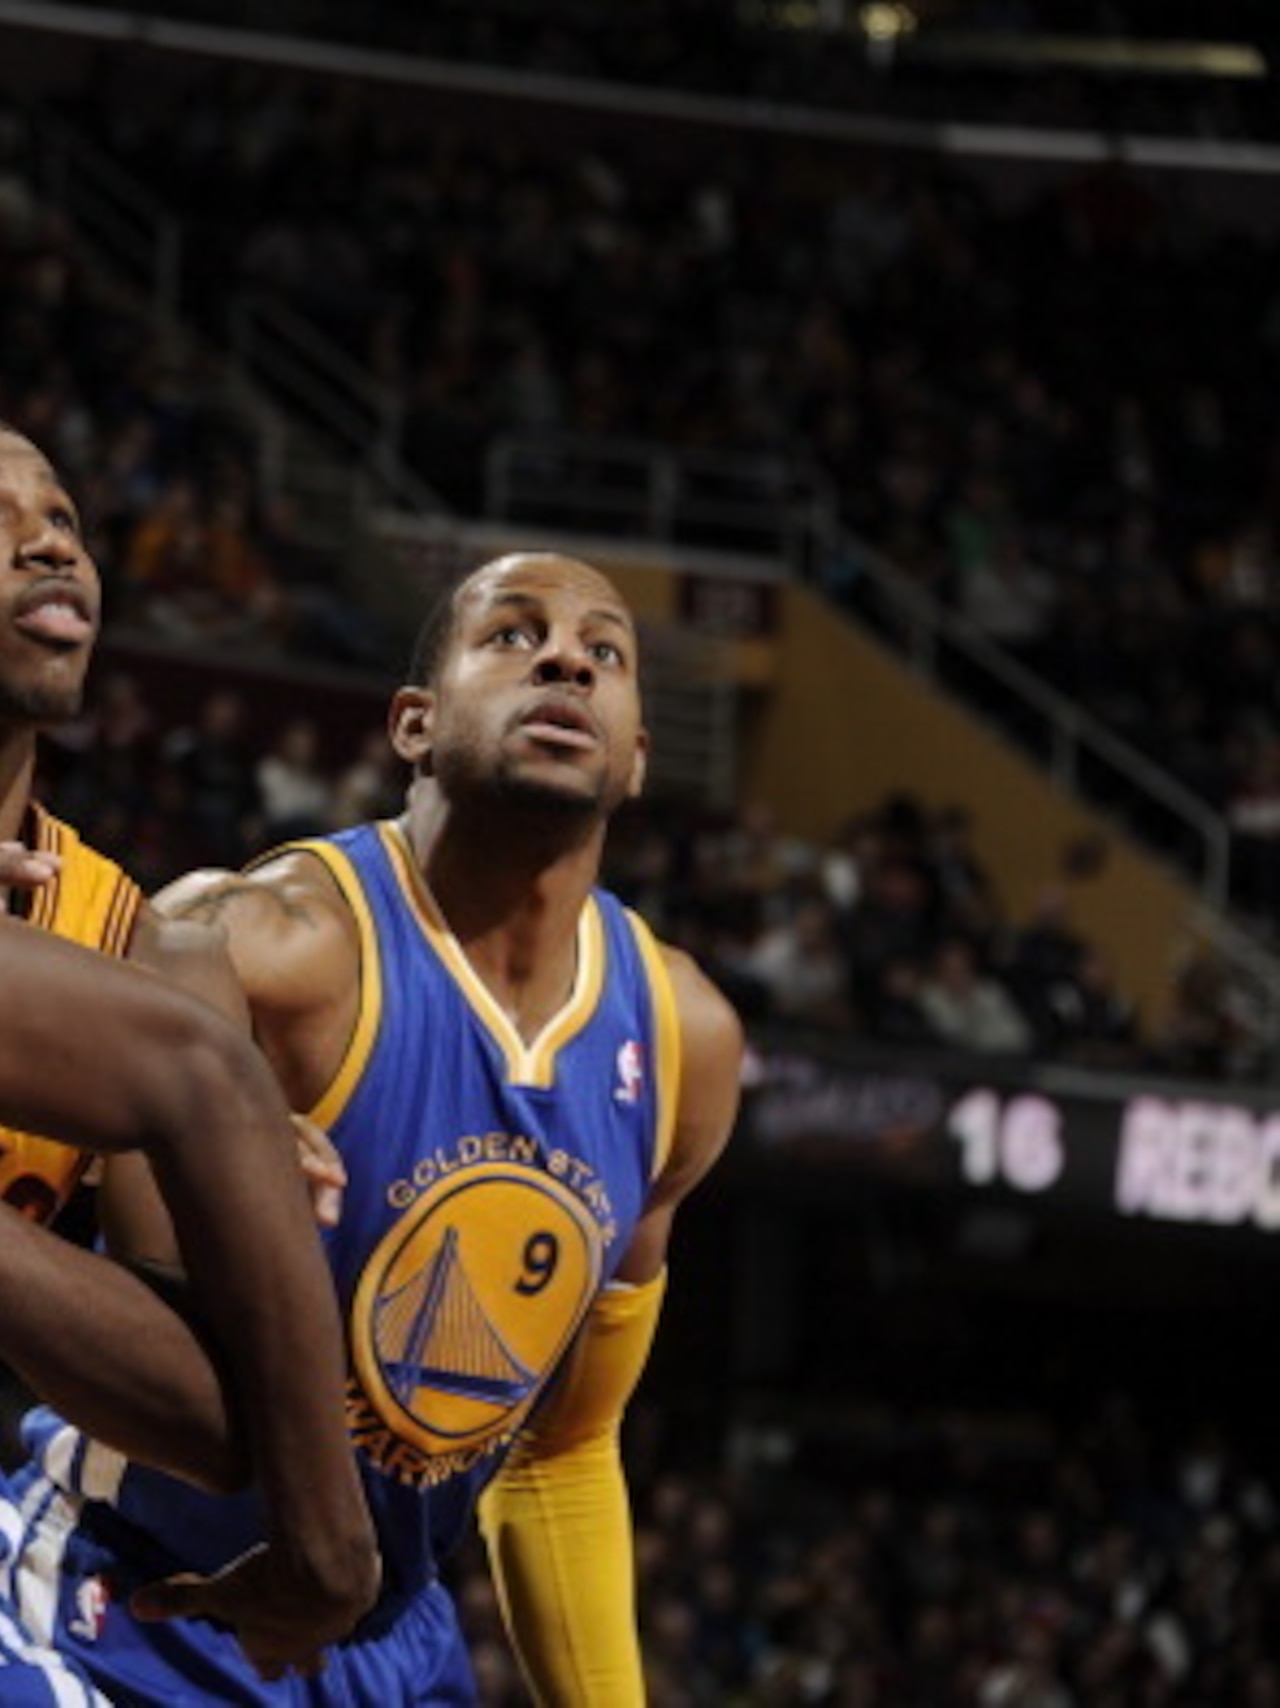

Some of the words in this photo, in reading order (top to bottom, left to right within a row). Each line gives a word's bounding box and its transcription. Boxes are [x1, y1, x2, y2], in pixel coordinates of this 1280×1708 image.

[387, 1131, 538, 1209] GOLDEN
[949, 1088, 1065, 1192] 16
[514, 1231, 558, 1296] 9
